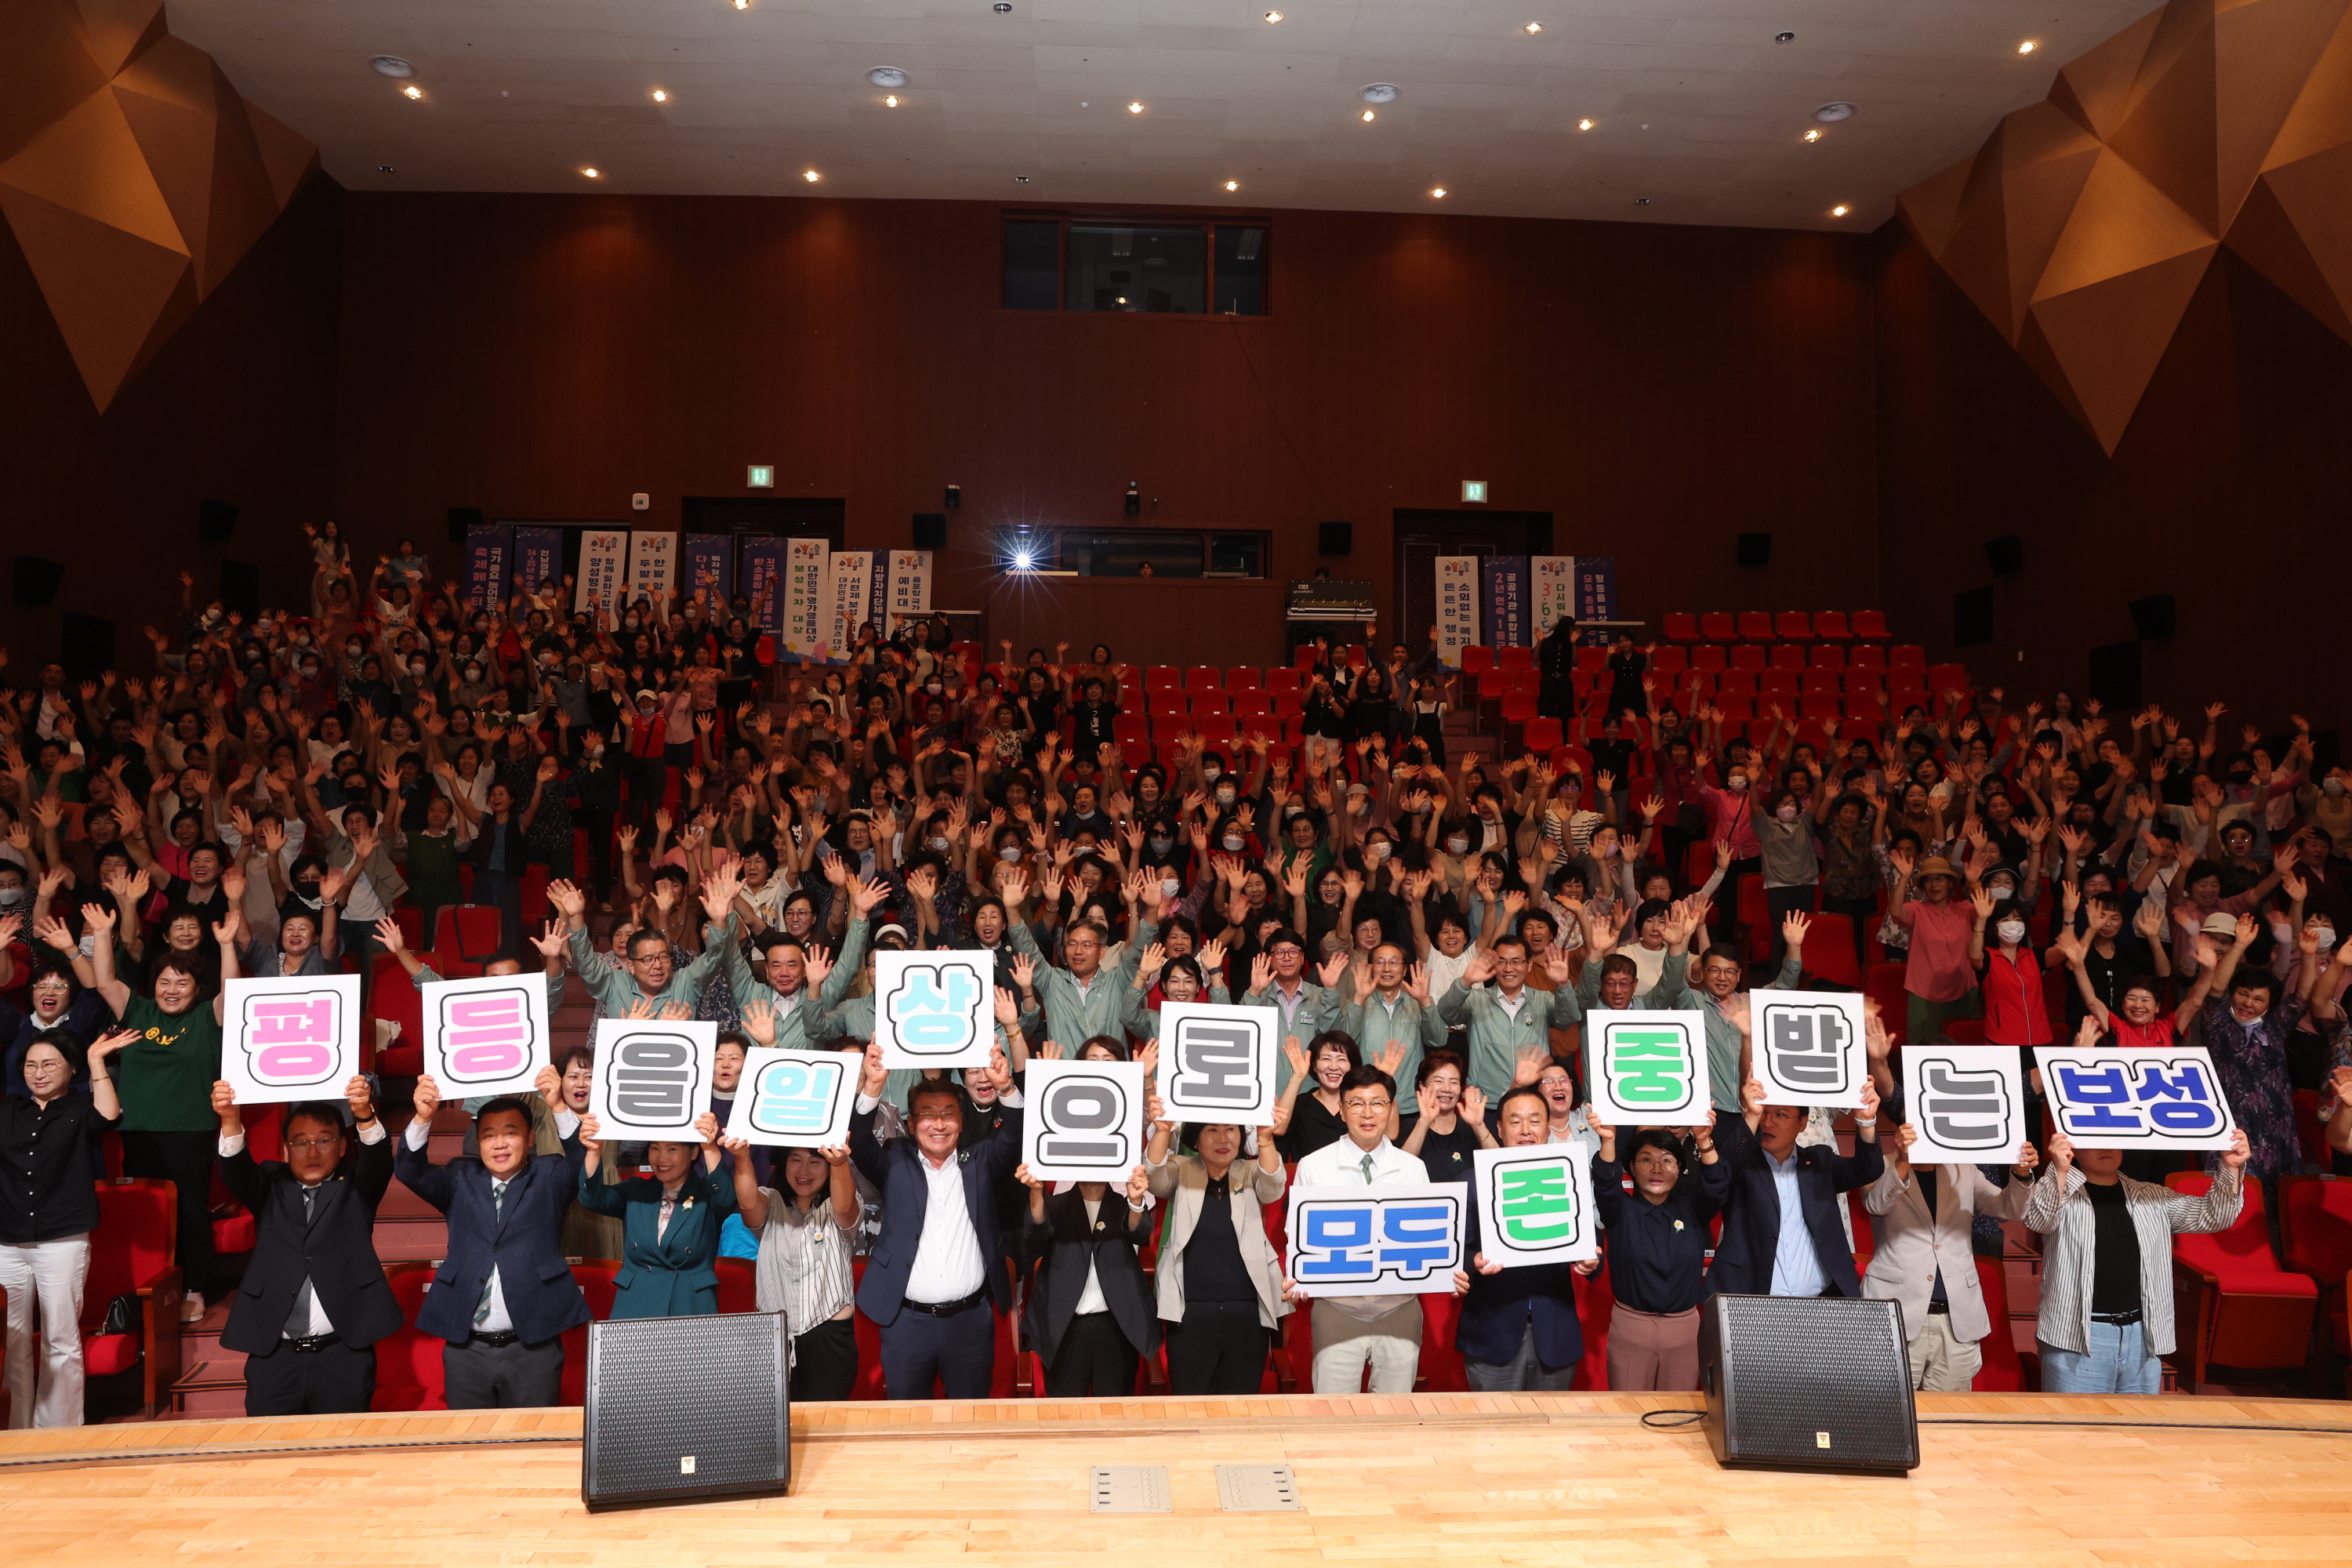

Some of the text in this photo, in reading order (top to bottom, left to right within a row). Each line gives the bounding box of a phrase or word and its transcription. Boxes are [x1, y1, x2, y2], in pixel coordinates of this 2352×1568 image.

[601, 575, 612, 597] 일하고
[604, 557, 615, 573] 함께
[807, 565, 818, 595] 대한민국
[837, 577, 848, 602] 대한민국
[849, 577, 860, 599] 서편제
[873, 565, 884, 614] 지방자치단체
[898, 576, 909, 608] 예비대
[1495, 572, 1504, 593] 2년
[1507, 573, 1518, 611] 공공기관
[1584, 575, 1593, 593] 모두
[1595, 574, 1606, 603] 평등을
[793, 615, 804, 634] 대상
[911, 598, 920, 610] 국가
[1444, 583, 1457, 646] 든든한 행정
[1459, 583, 1471, 645] 소외없는 복지
[1495, 597, 1505, 615] 연속
[252, 998, 332, 1077] 평
[449, 997, 524, 1074] 등
[897, 972, 973, 1046] 상
[616, 1042, 688, 1116] 을
[1185, 1027, 1253, 1101] 로
[1614, 1031, 1686, 1102] 중
[1773, 1013, 1843, 1085] 받
[759, 1066, 834, 1127] 일
[1047, 1085, 1118, 1157] 으
[1929, 1068, 2001, 1142] 는
[2060, 1065, 2216, 1130] 보성
[1501, 1166, 1570, 1243] 존
[1303, 1205, 1451, 1276] 모두
